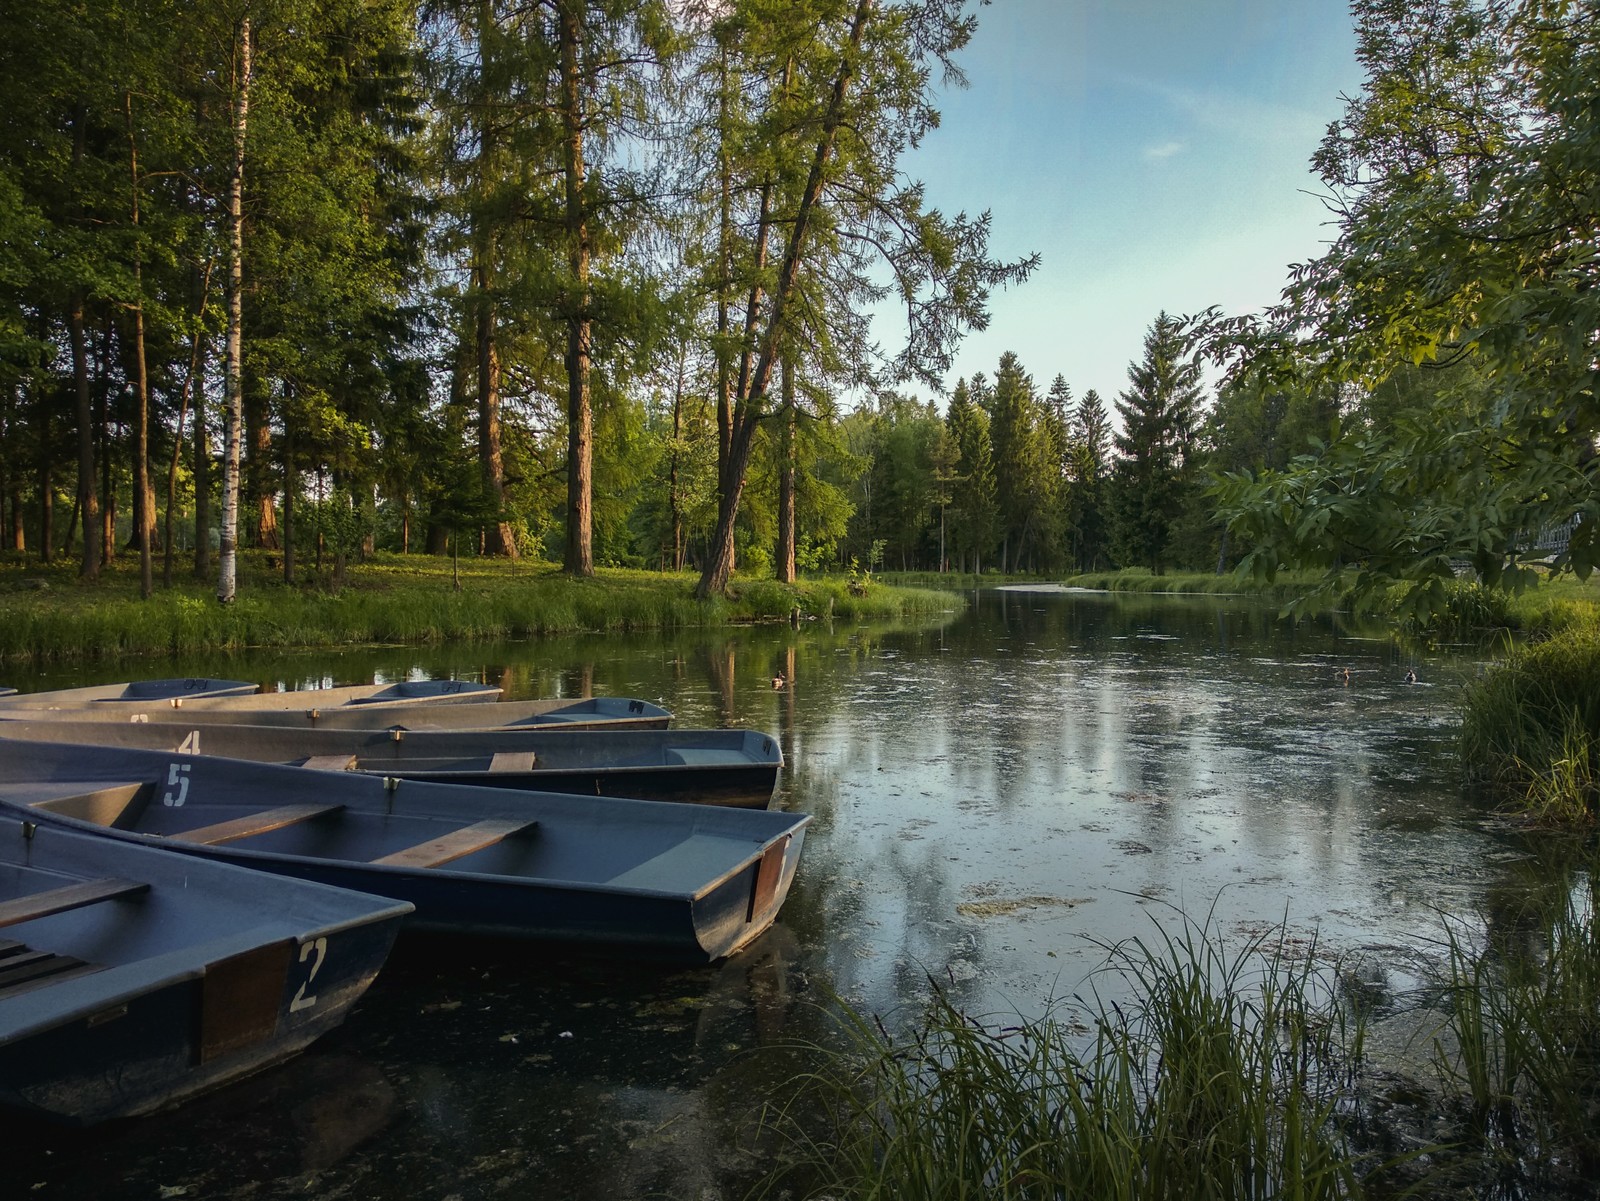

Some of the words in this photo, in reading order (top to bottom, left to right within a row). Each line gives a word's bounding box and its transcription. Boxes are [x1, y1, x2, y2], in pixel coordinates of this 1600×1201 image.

[178, 730, 201, 755] 4
[163, 763, 192, 807] 5
[289, 936, 328, 1013] 2
